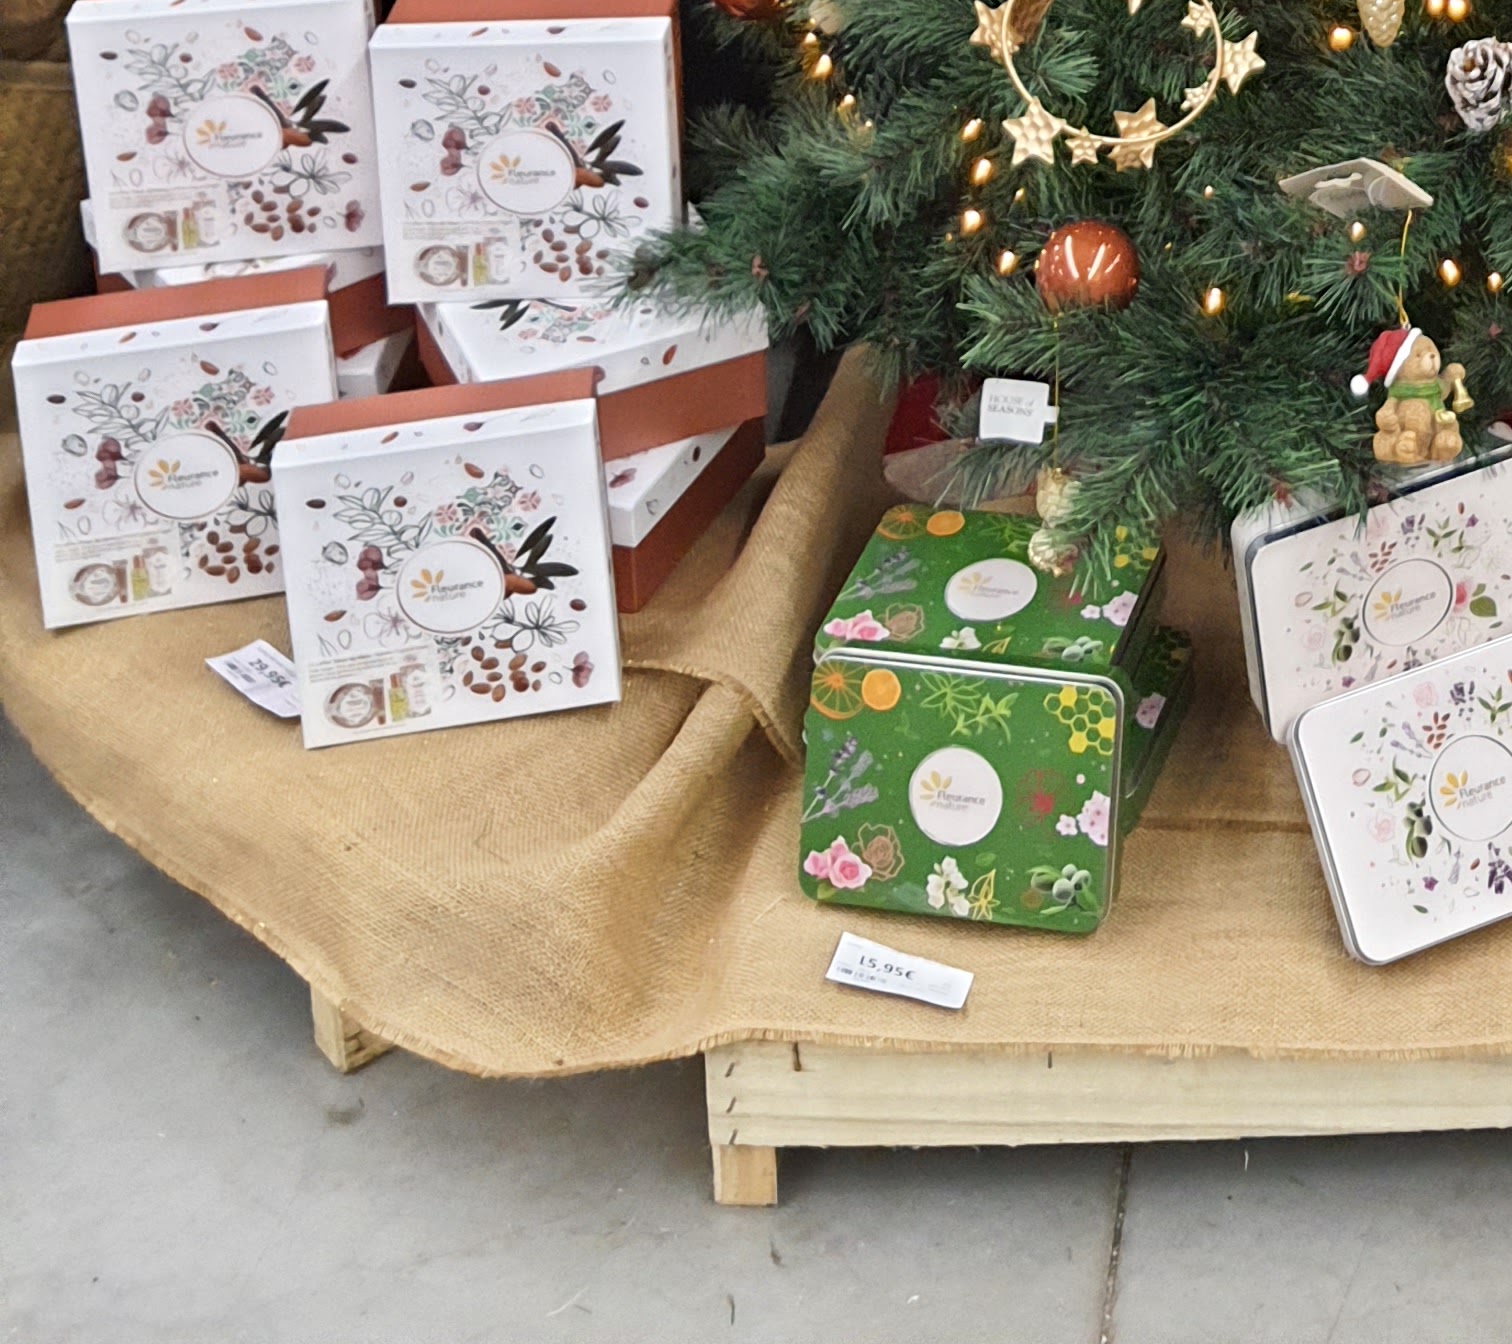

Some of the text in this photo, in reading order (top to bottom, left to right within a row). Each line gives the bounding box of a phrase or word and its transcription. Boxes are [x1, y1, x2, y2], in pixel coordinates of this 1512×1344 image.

[936, 790, 987, 807] Fleurance
[1458, 775, 1507, 800] Fleurance
[858, 954, 919, 981] 15,95€
